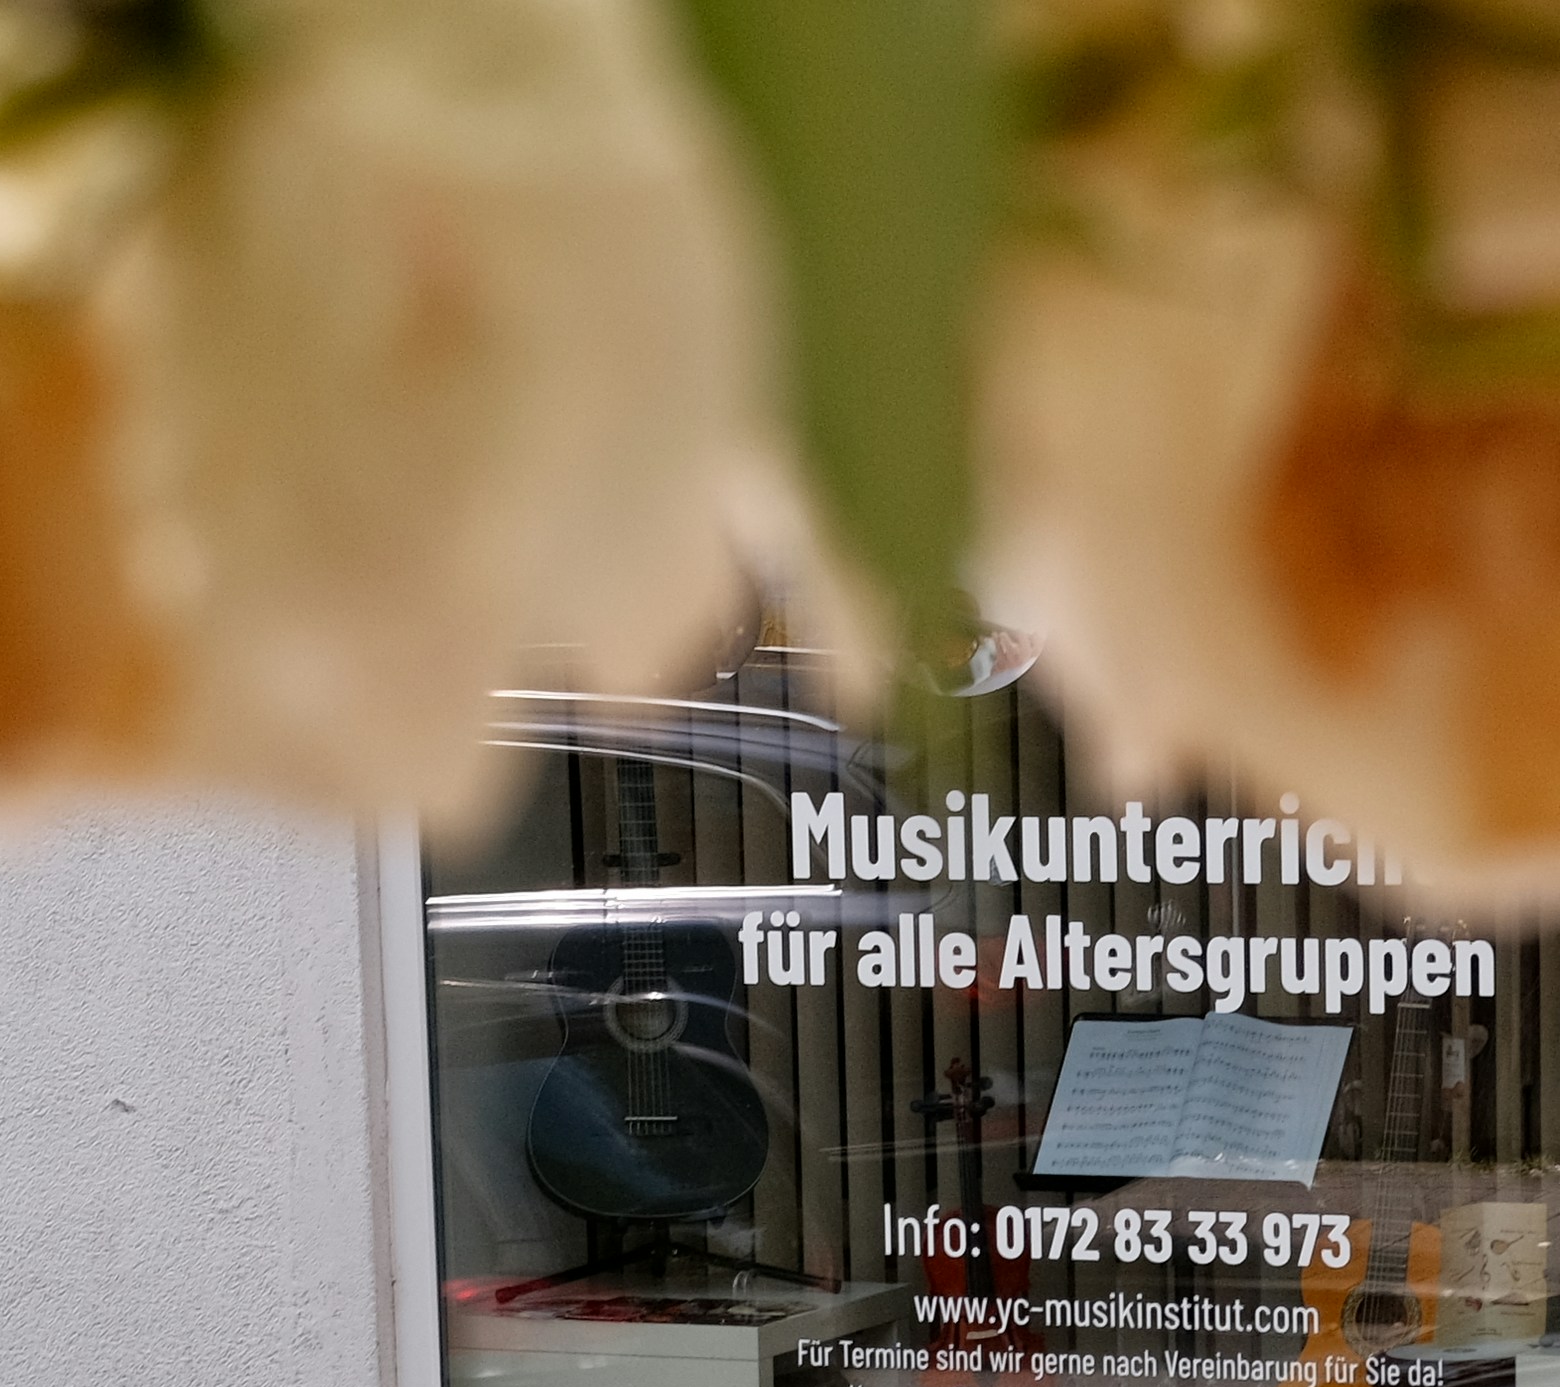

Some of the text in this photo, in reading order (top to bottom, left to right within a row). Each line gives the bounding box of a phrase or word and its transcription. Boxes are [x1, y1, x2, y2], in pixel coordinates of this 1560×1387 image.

[789, 790, 1416, 887] Musikunterrich
[738, 908, 1499, 1015] für alle Altersgruppen
[883, 1202, 1351, 1269] Info: 0172 83 33 973
[913, 1292, 1320, 1335] www.yc-musikinstitut.com
[797, 1338, 834, 1367] Für
[838, 1339, 929, 1371] Termine
[936, 1343, 982, 1372] sind
[989, 1345, 1025, 1374] wir
[1031, 1352, 1095, 1381] gerne
[1102, 1351, 1157, 1378] nach
[1324, 1357, 1359, 1384] für
[1365, 1354, 1401, 1386] Sie
[1407, 1359, 1444, 1387] da!
